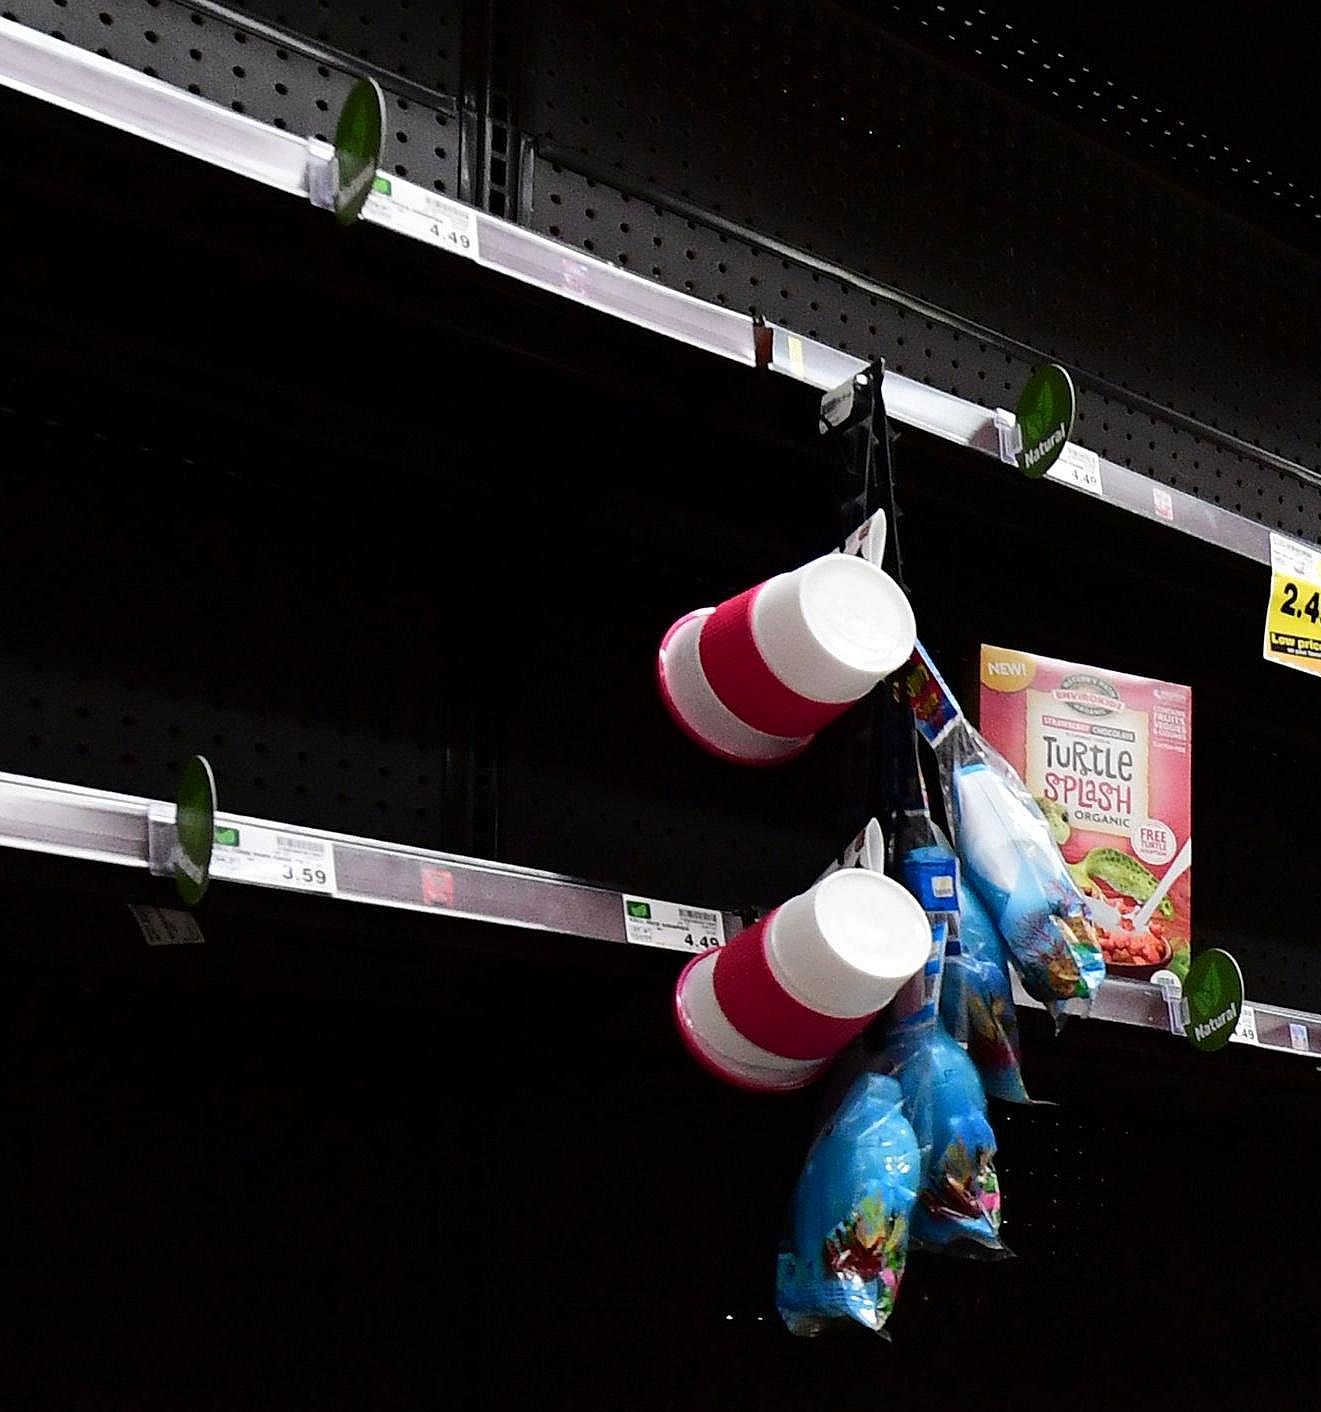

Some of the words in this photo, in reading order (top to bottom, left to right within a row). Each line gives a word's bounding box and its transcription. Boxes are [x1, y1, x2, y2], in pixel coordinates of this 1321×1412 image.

[430, 224, 470, 249] 4.49
[1024, 422, 1066, 469] Natural
[1272, 633, 1295, 647] Low
[988, 662, 1026, 676] NEW!
[1074, 810, 1131, 828] ORGANIC
[1140, 827, 1167, 843] FREE
[282, 866, 327, 885] 3.59
[684, 934, 720, 947] 4.49
[1194, 1002, 1238, 1042] Natural
